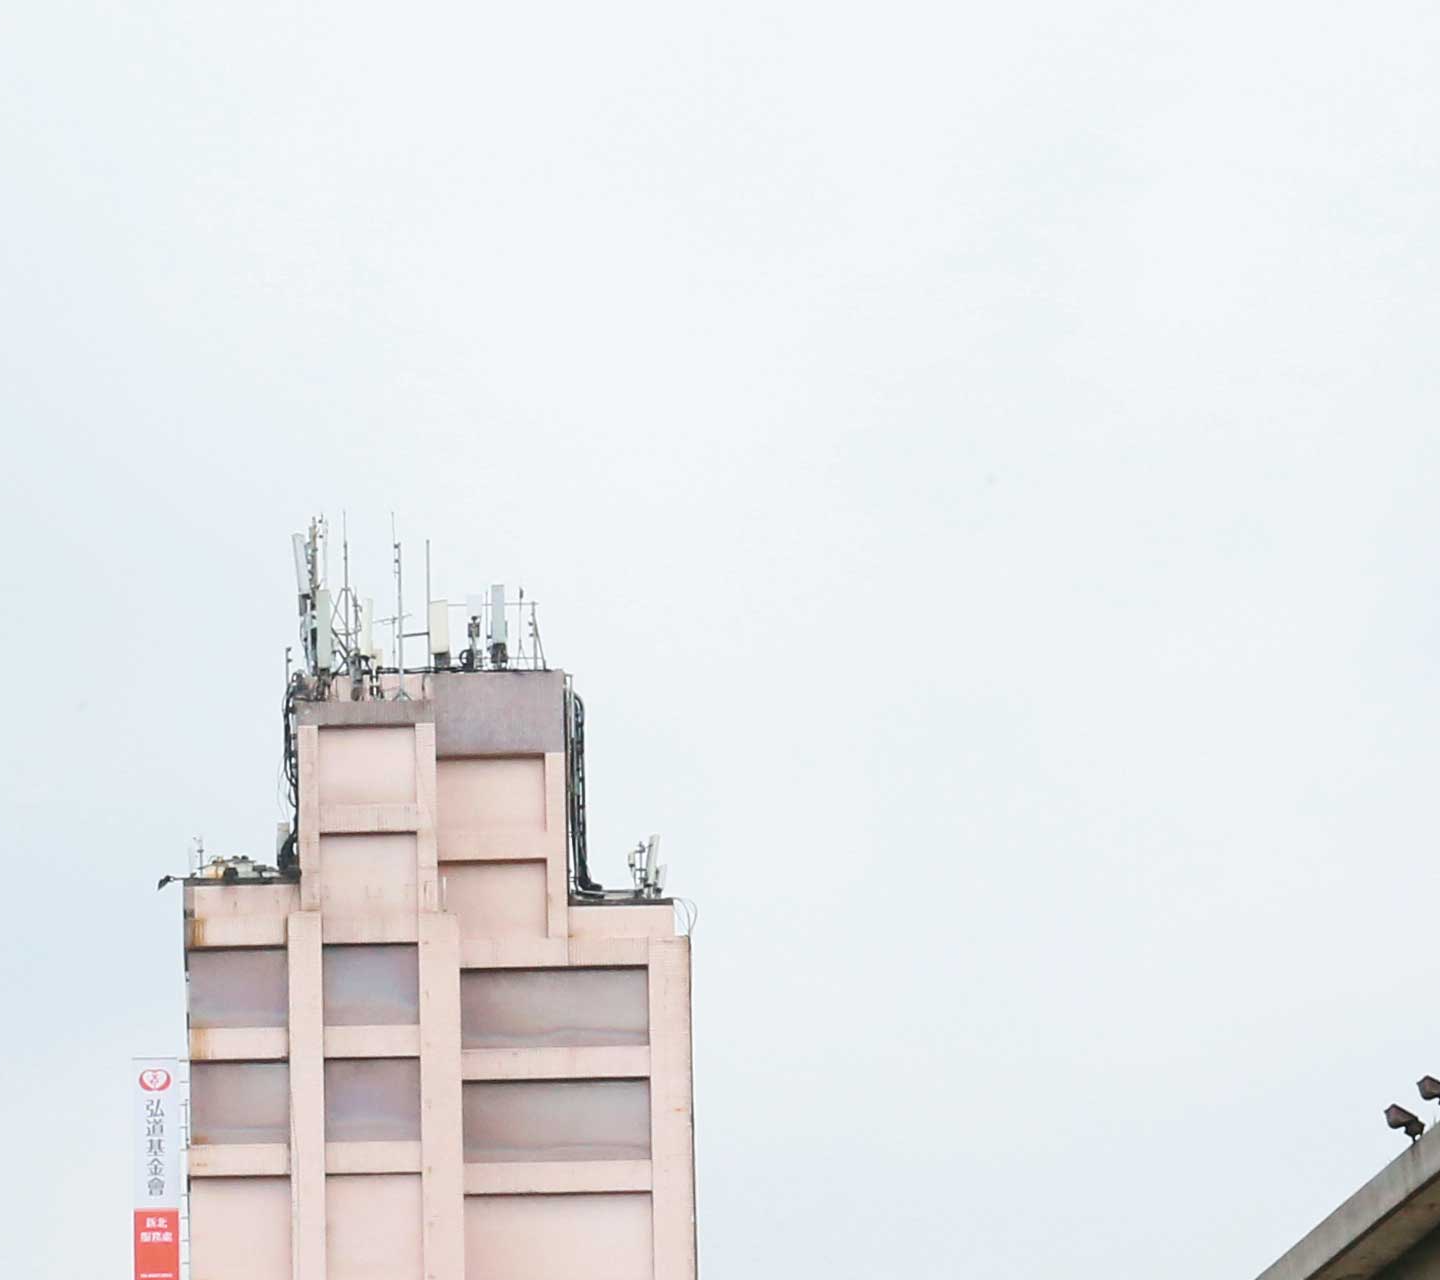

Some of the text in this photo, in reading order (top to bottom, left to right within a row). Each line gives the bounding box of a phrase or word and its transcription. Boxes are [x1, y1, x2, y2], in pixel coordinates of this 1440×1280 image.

[145, 1099, 165, 1196] 弘道基金會
